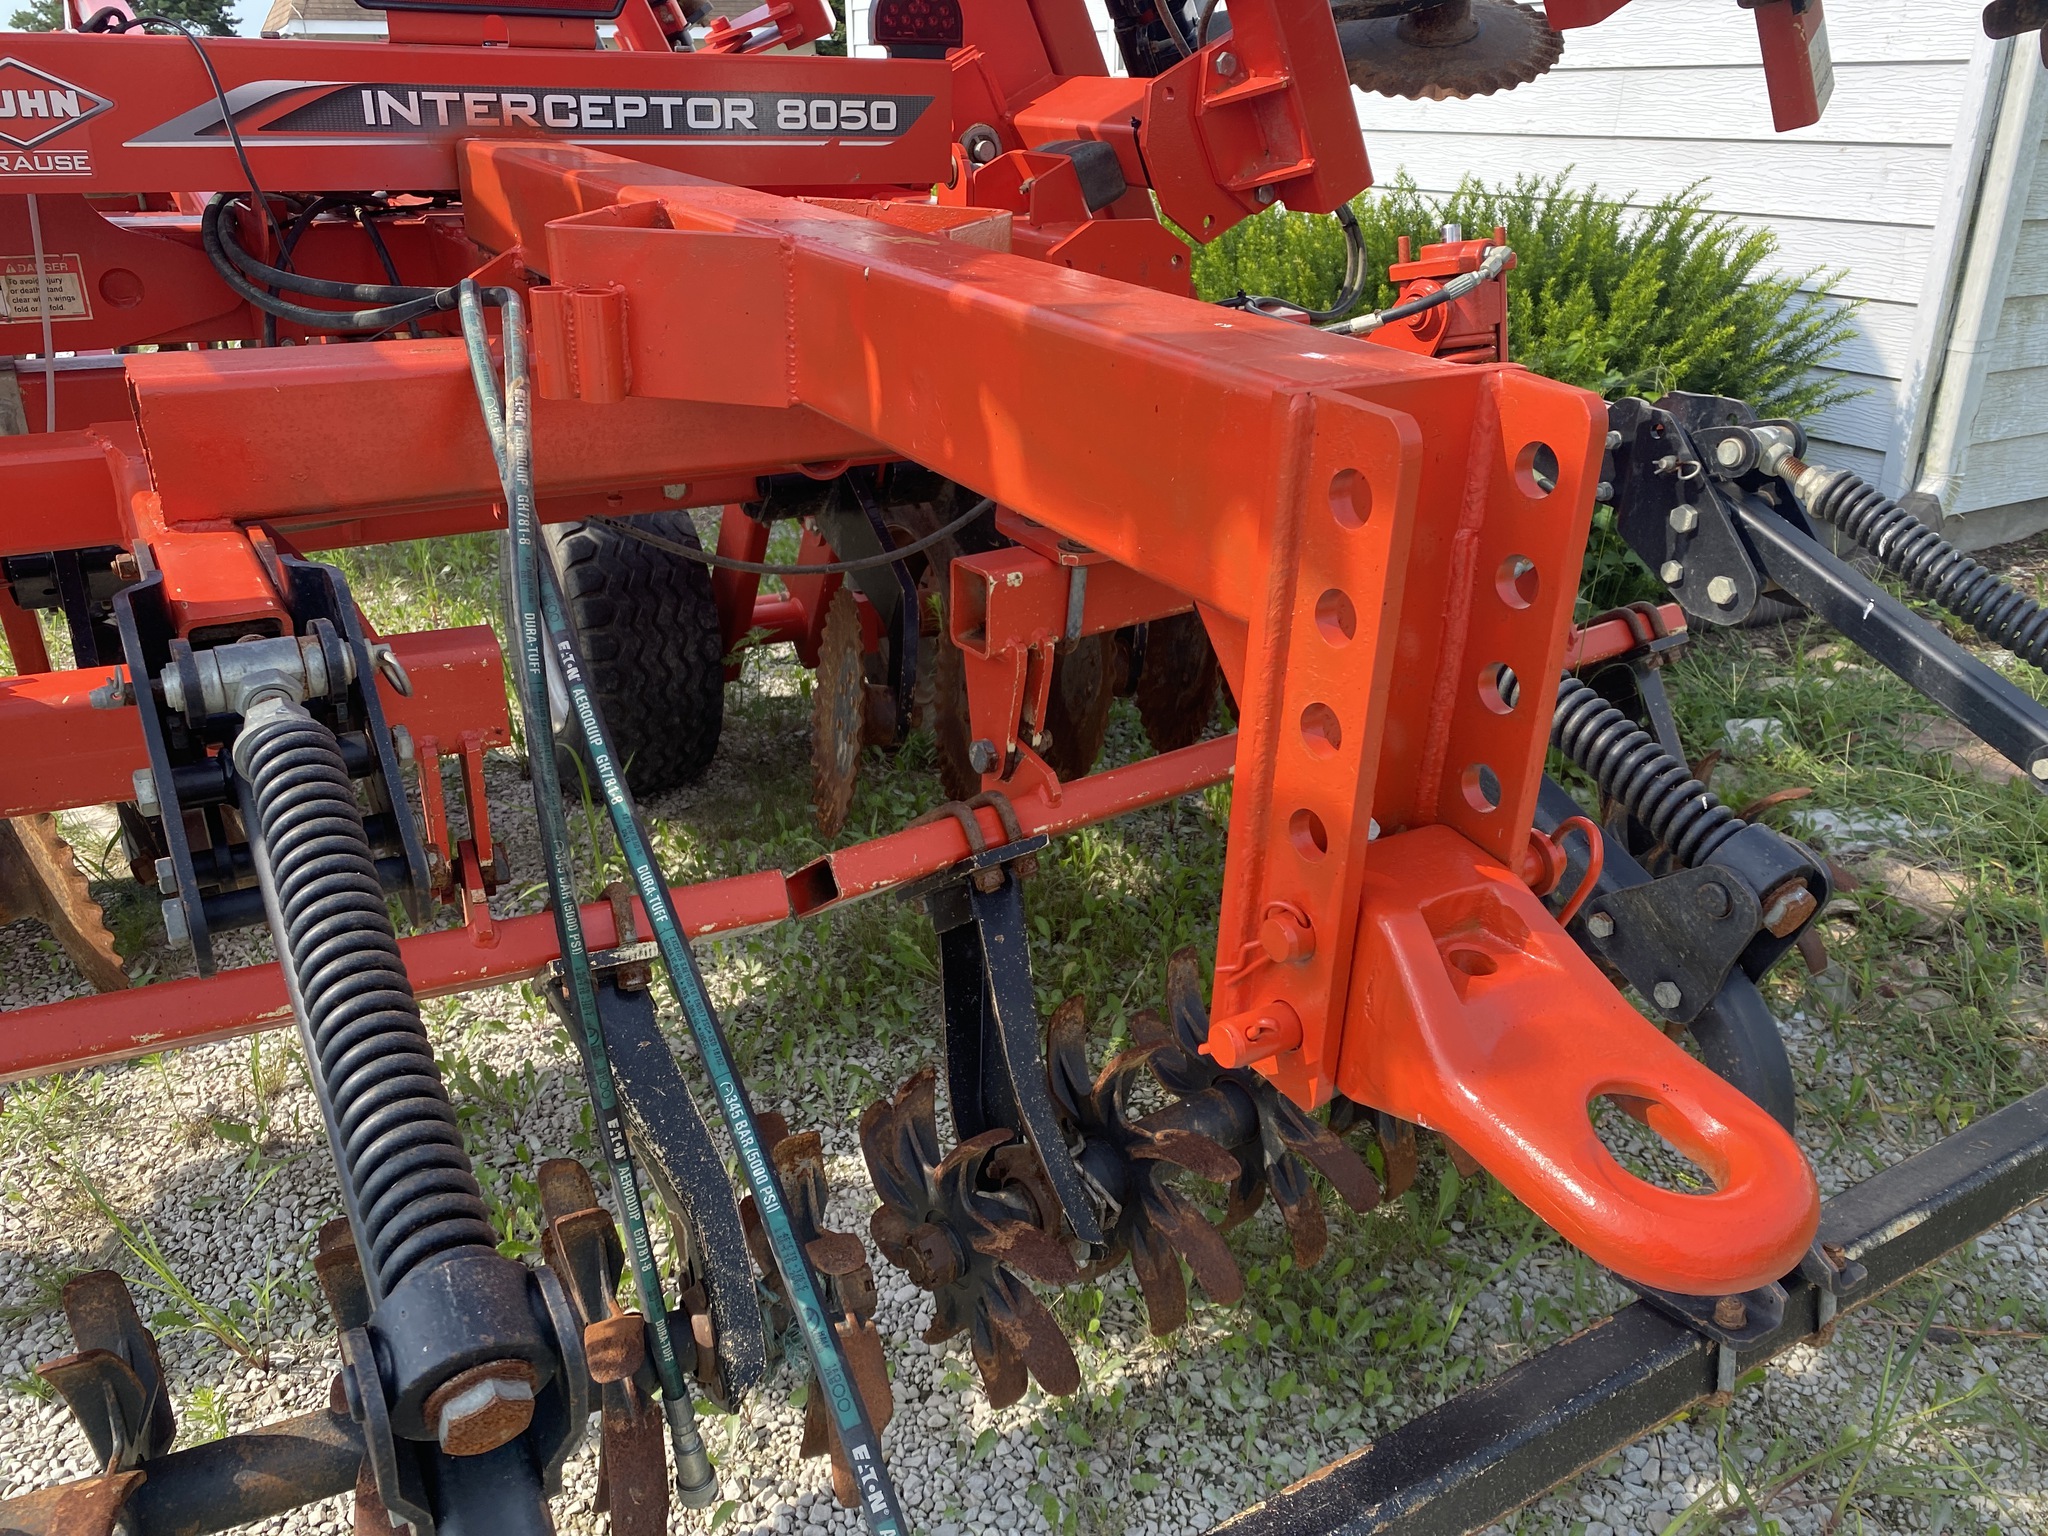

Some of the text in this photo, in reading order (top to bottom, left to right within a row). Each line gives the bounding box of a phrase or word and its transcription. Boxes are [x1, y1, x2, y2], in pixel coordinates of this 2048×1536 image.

[361, 89, 897, 131] INTERCEPTOR 8050
[17, 262, 69, 273] DAGER
[12, 296, 31, 304] clear
[54, 294, 76, 303] wings
[14, 305, 29, 313] fold
[517, 494, 531, 546] GH781-8
[523, 612, 540, 674] DURA-TUFF
[572, 687, 603, 747] AEROQUIP
[596, 754, 624, 806] GH781-8
[636, 864, 668, 924] DURA-TUFF
[562, 901, 578, 931] (5000
[568, 933, 582, 955] PSI)
[724, 1094, 780, 1213] 345 BAR (5000 PSI)
[617, 1166, 640, 1221] AEROQUIP
[632, 1227, 652, 1272] GH781-8
[654, 1319, 674, 1363] DURA-TUFF
